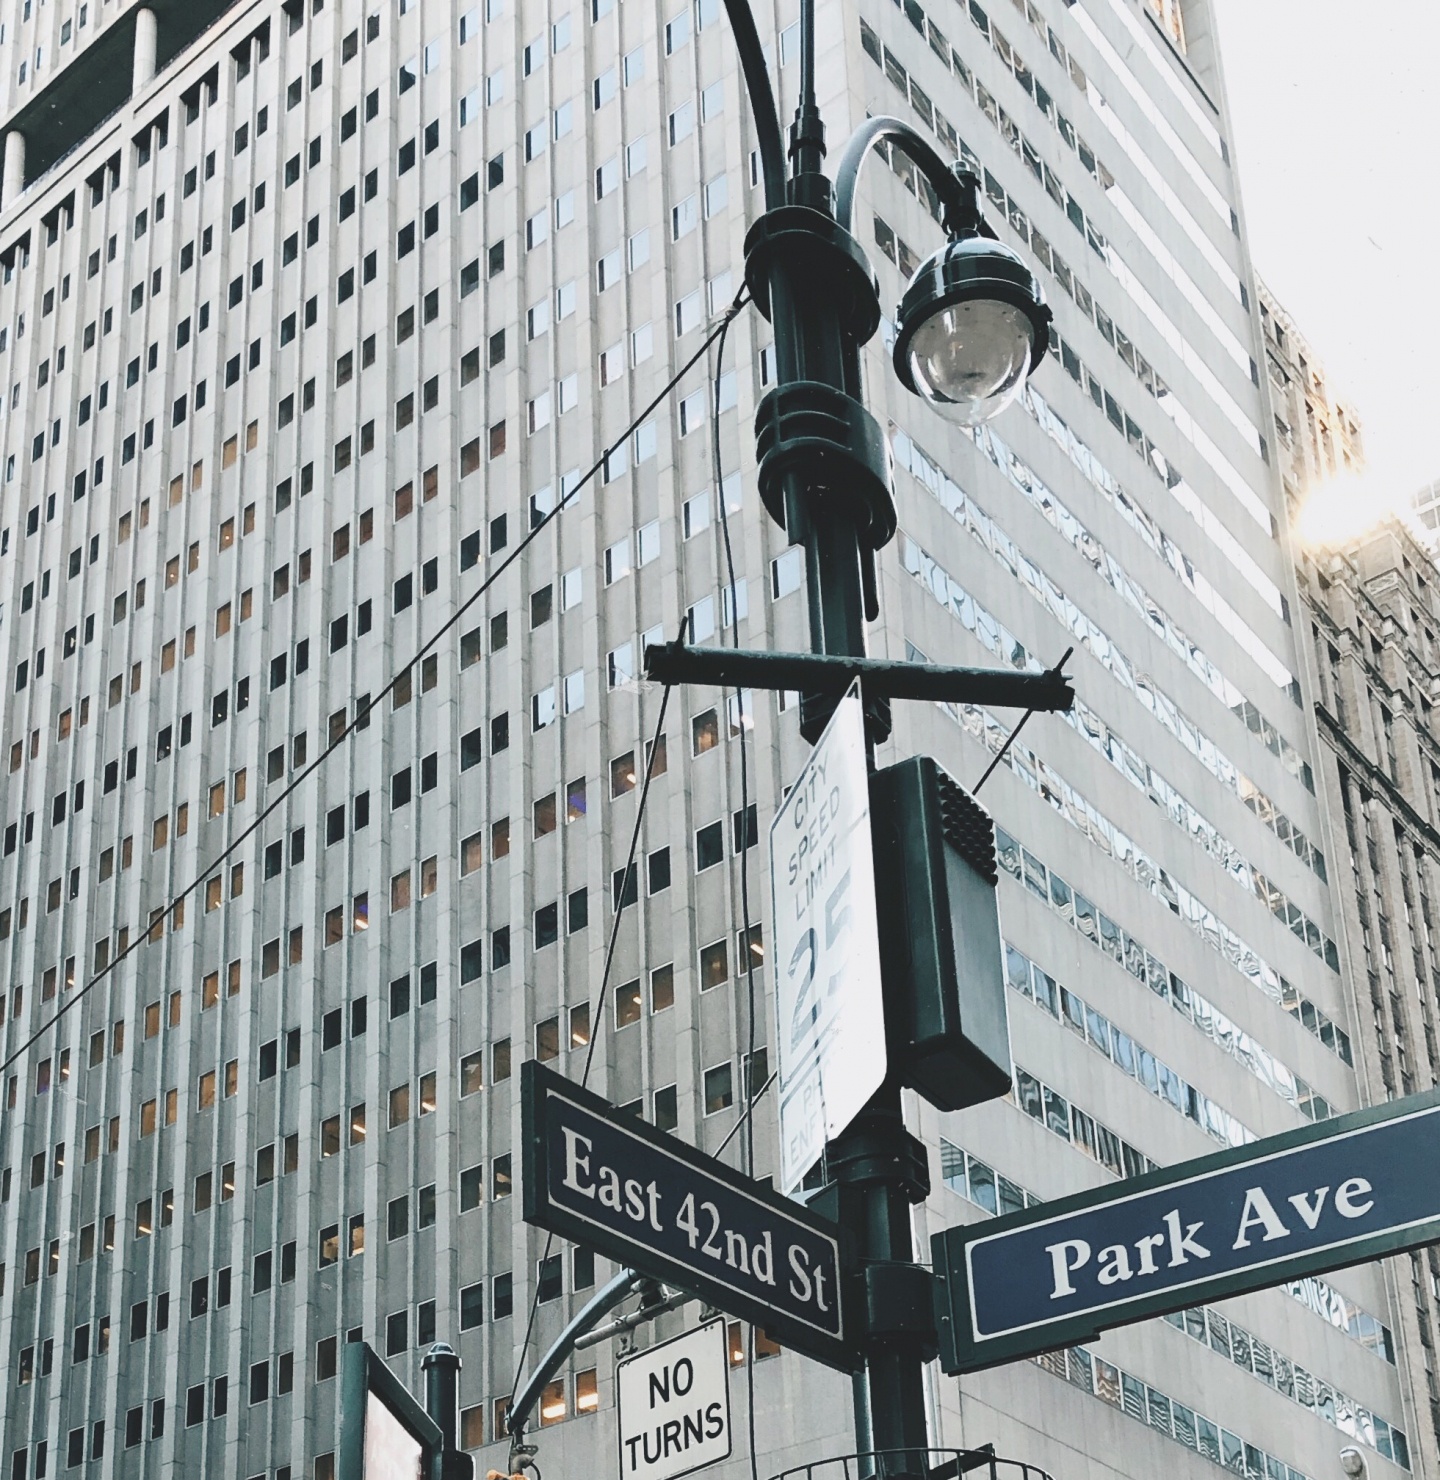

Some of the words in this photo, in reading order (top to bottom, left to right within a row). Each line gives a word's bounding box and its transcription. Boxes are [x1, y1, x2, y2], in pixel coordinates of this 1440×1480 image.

[788, 785, 840, 886] SPEED
[794, 751, 829, 829] CITY
[795, 835, 837, 921] LIMIT
[787, 868, 854, 1055] 25
[561, 1126, 663, 1232] East
[676, 1193, 776, 1286] 42nd
[788, 1244, 828, 1312] St
[1045, 1209, 1211, 1299] Park
[1232, 1177, 1375, 1250] Ave
[649, 1357, 694, 1409] NO
[625, 1402, 724, 1471] TURNS
